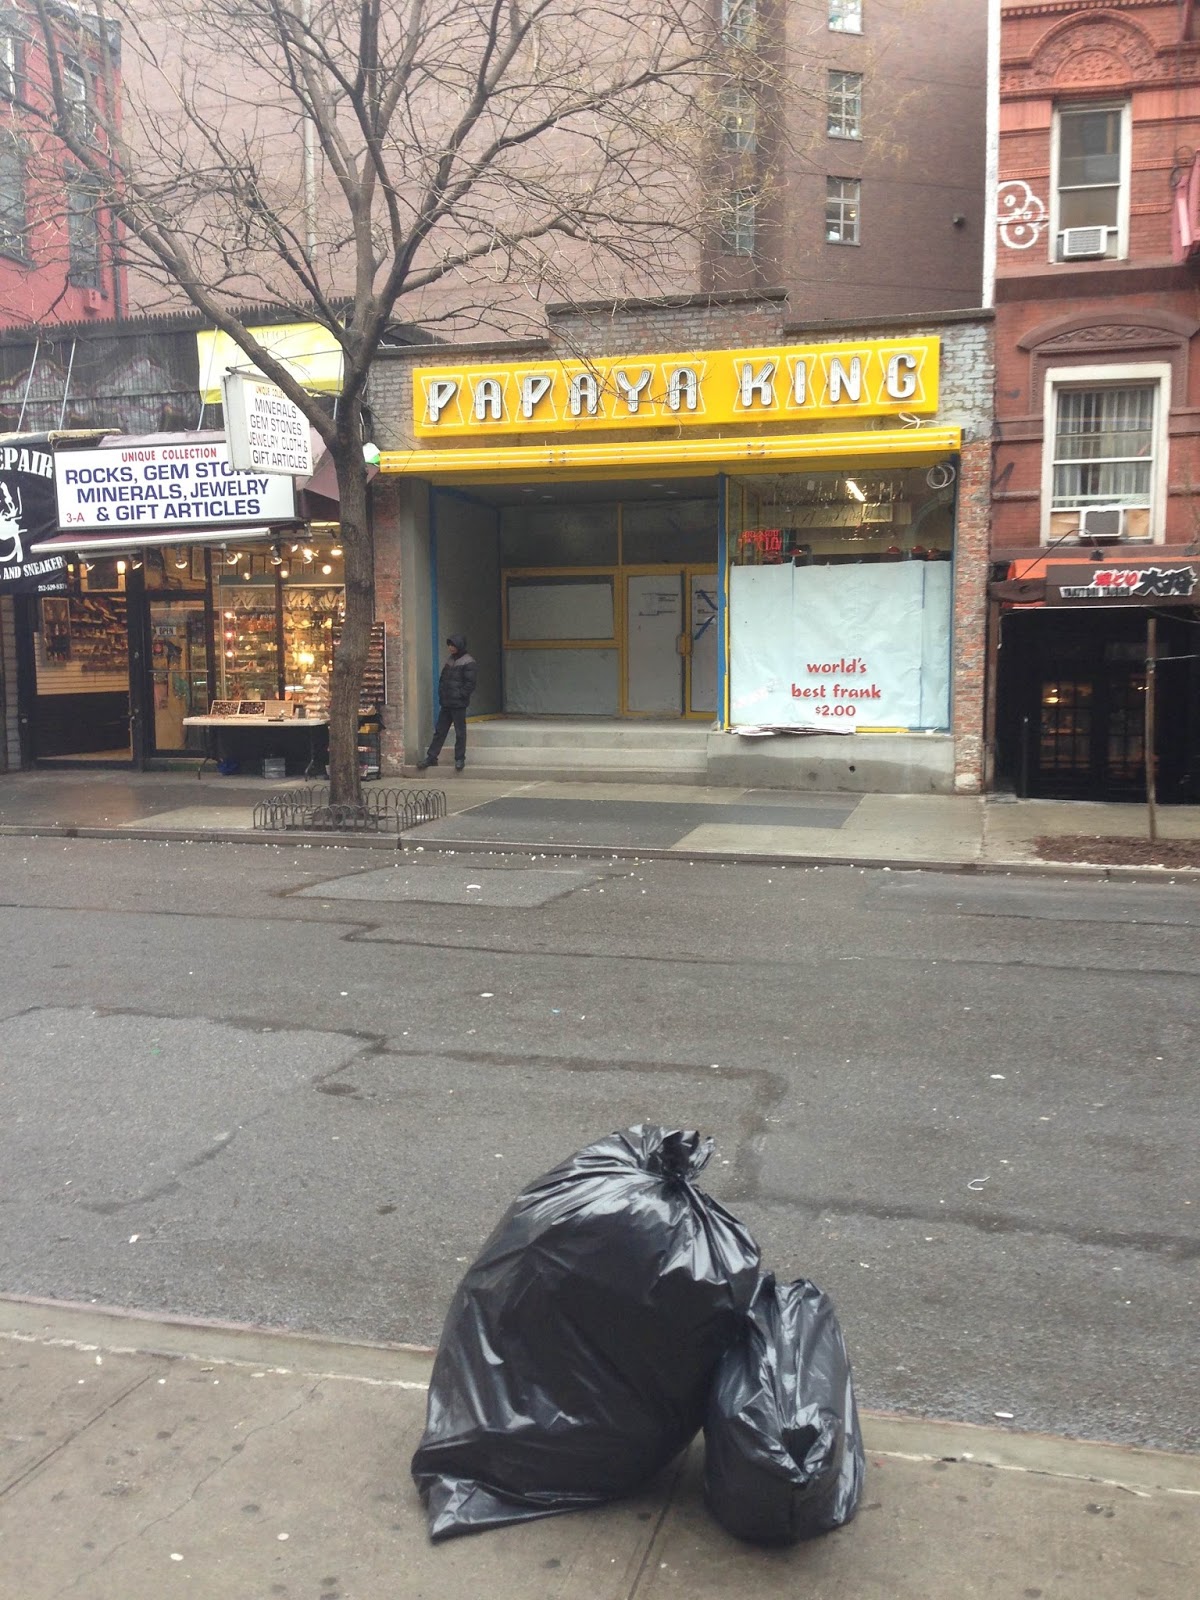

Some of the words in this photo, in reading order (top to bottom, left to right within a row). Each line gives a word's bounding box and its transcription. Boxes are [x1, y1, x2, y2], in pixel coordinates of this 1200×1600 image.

[429, 368, 698, 423] PAPAYA
[740, 353, 917, 407] KING
[255, 398, 297, 419] MINERALS
[250, 414, 268, 430] GEM
[270, 418, 302, 435] STONES
[249, 431, 279, 449] JEWELRY
[281, 436, 302, 451] CLOTH
[0, 447, 53, 480] PAIR
[122, 450, 156, 462] UNIQUE
[162, 448, 217, 460] COLLECTION
[253, 449, 270, 465] GIFT
[272, 452, 308, 469] ARTICLES
[65, 467, 138, 484] ROCKS,
[143, 464, 189, 480] GEM
[77, 484, 187, 503] MINERALS,
[190, 479, 269, 498] JEWELRY
[66, 512, 85, 523] 3-A
[96, 506, 110, 521] &
[116, 504, 158, 520] GIFT
[163, 499, 261, 518] ARTICLES
[3, 566, 21, 580] AND
[806, 657, 867, 674] world's
[791, 683, 826, 698] best
[833, 683, 882, 698] frank
[815, 705, 856, 717] $2.00
